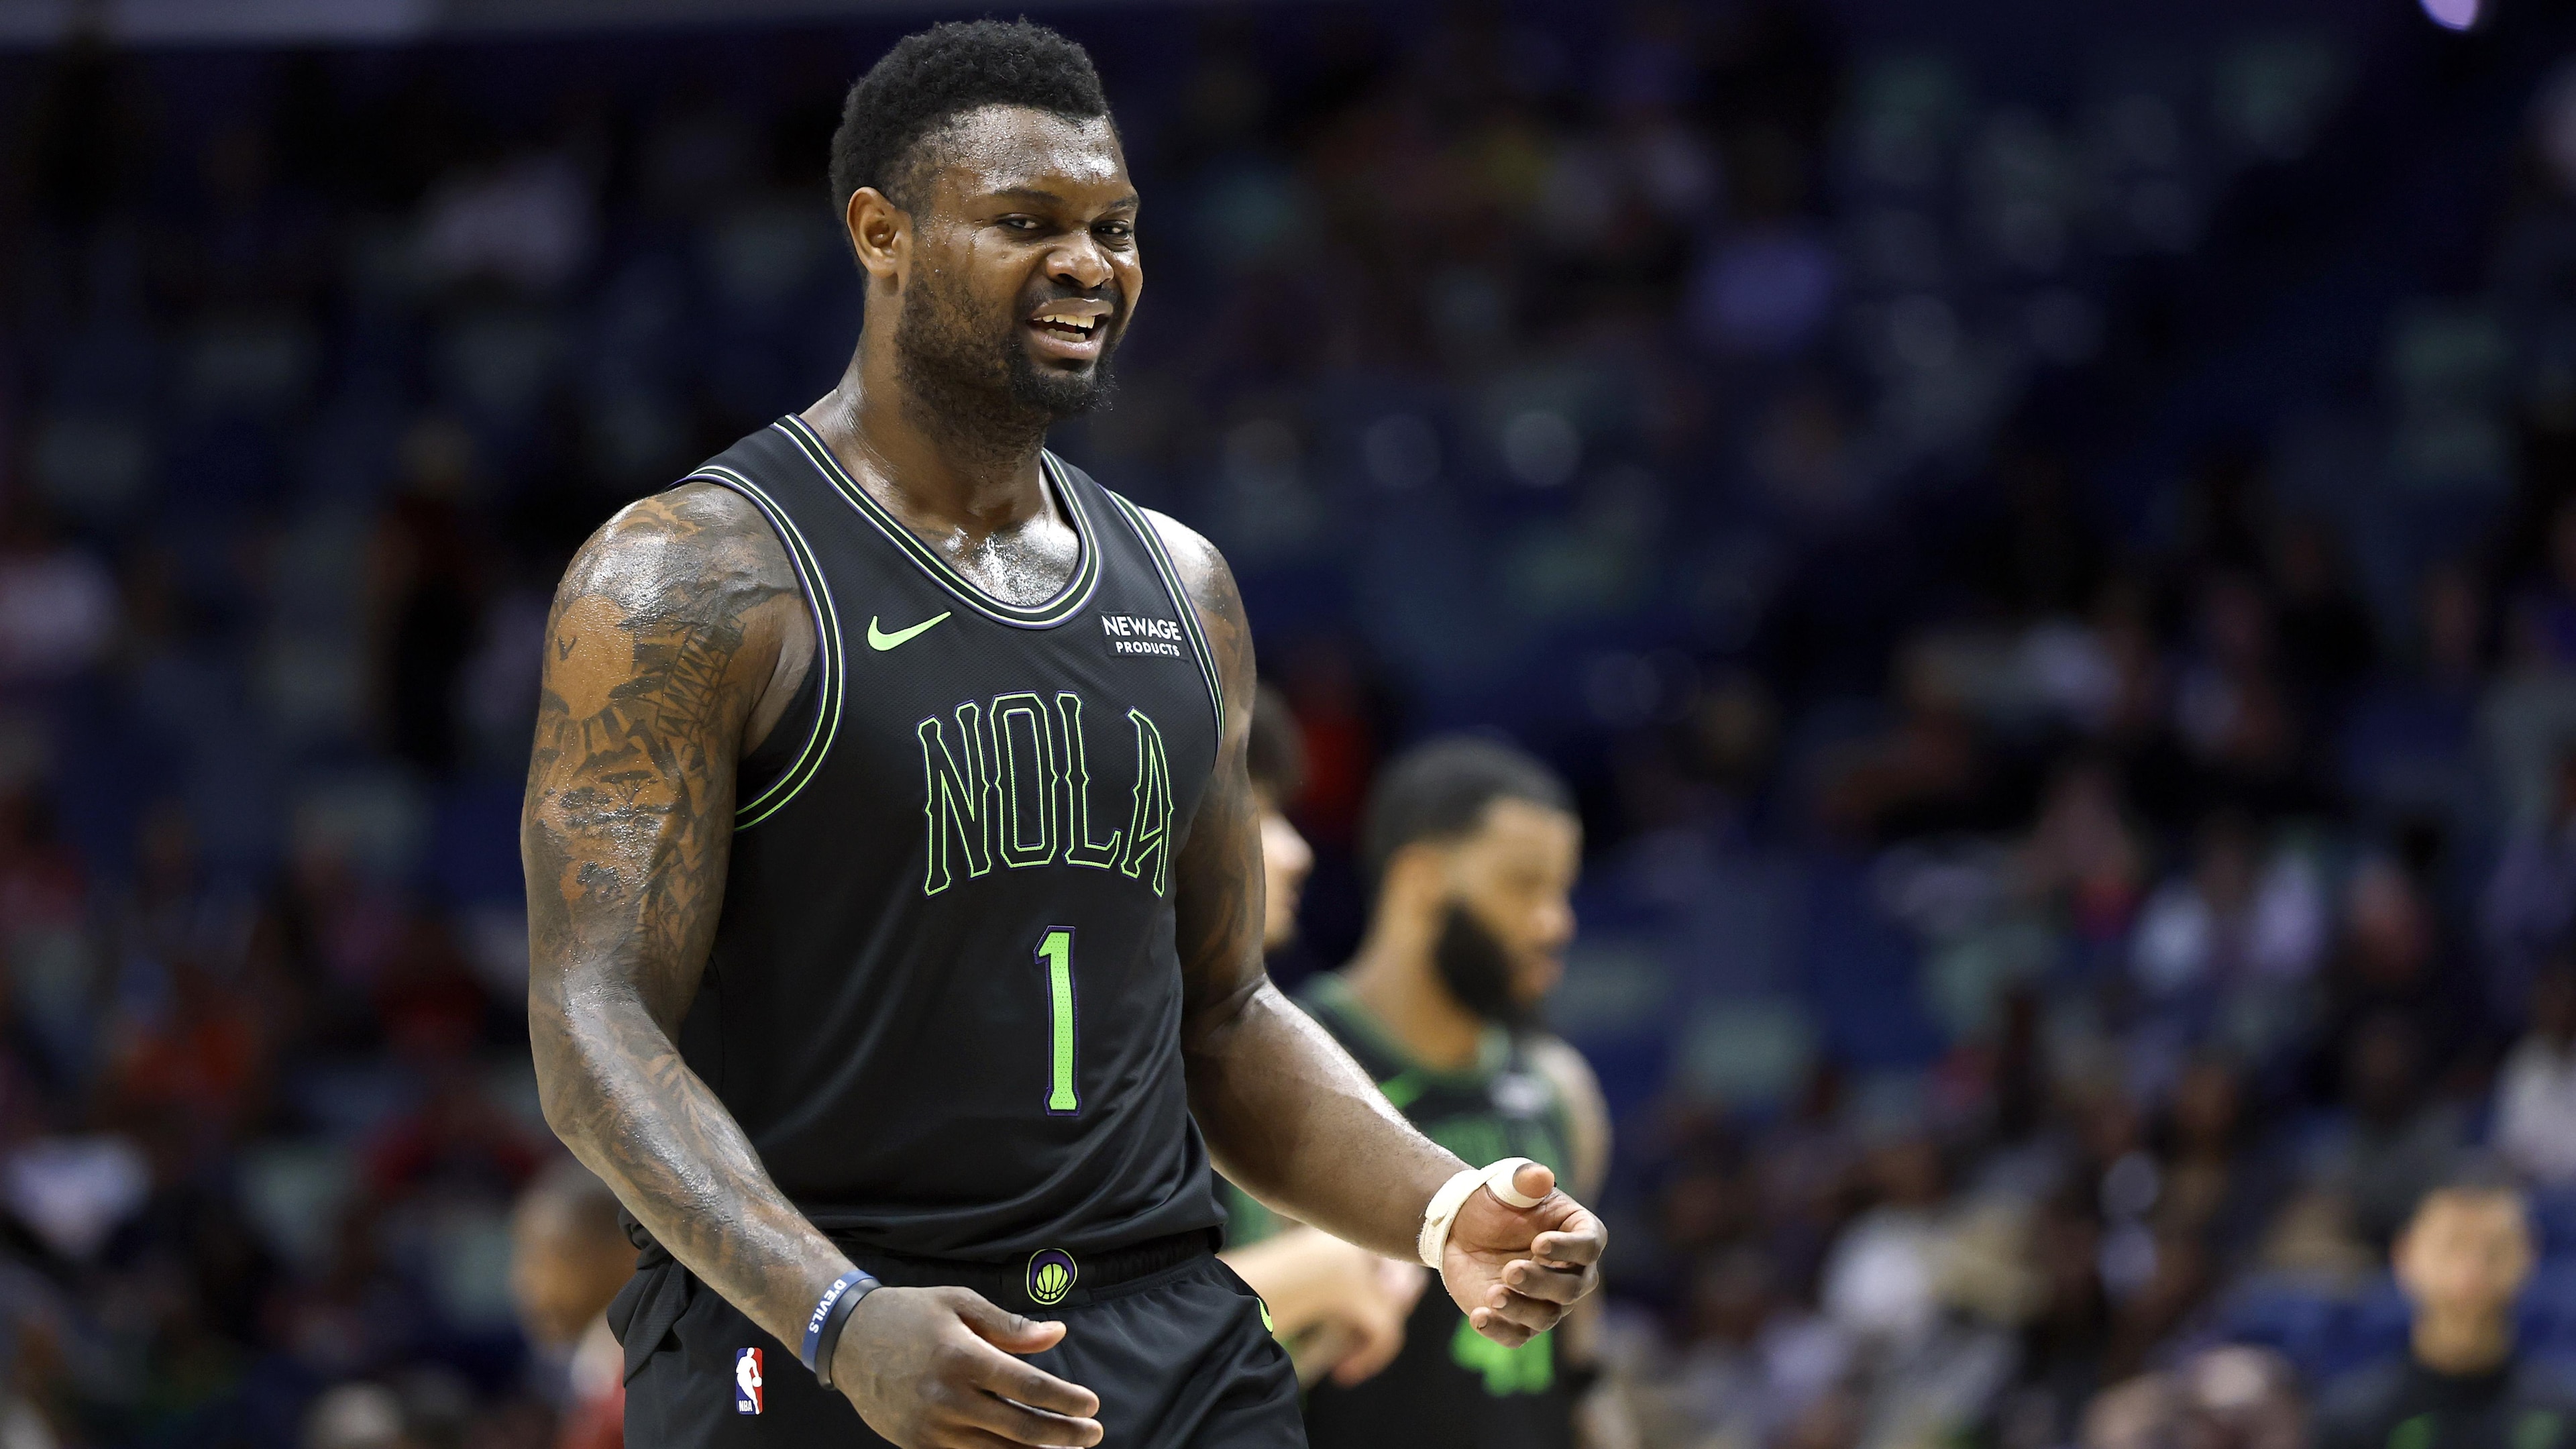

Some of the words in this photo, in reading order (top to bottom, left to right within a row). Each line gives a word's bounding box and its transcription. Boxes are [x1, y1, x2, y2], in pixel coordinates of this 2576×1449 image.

[1101, 614, 1182, 641] NEWAGE
[1115, 641, 1181, 657] PRODUCTS
[917, 690, 1174, 898] NOLA
[1034, 926, 1081, 1115] 1
[808, 1279, 847, 1334] D'EVILS
[738, 1400, 753, 1412] NBA
